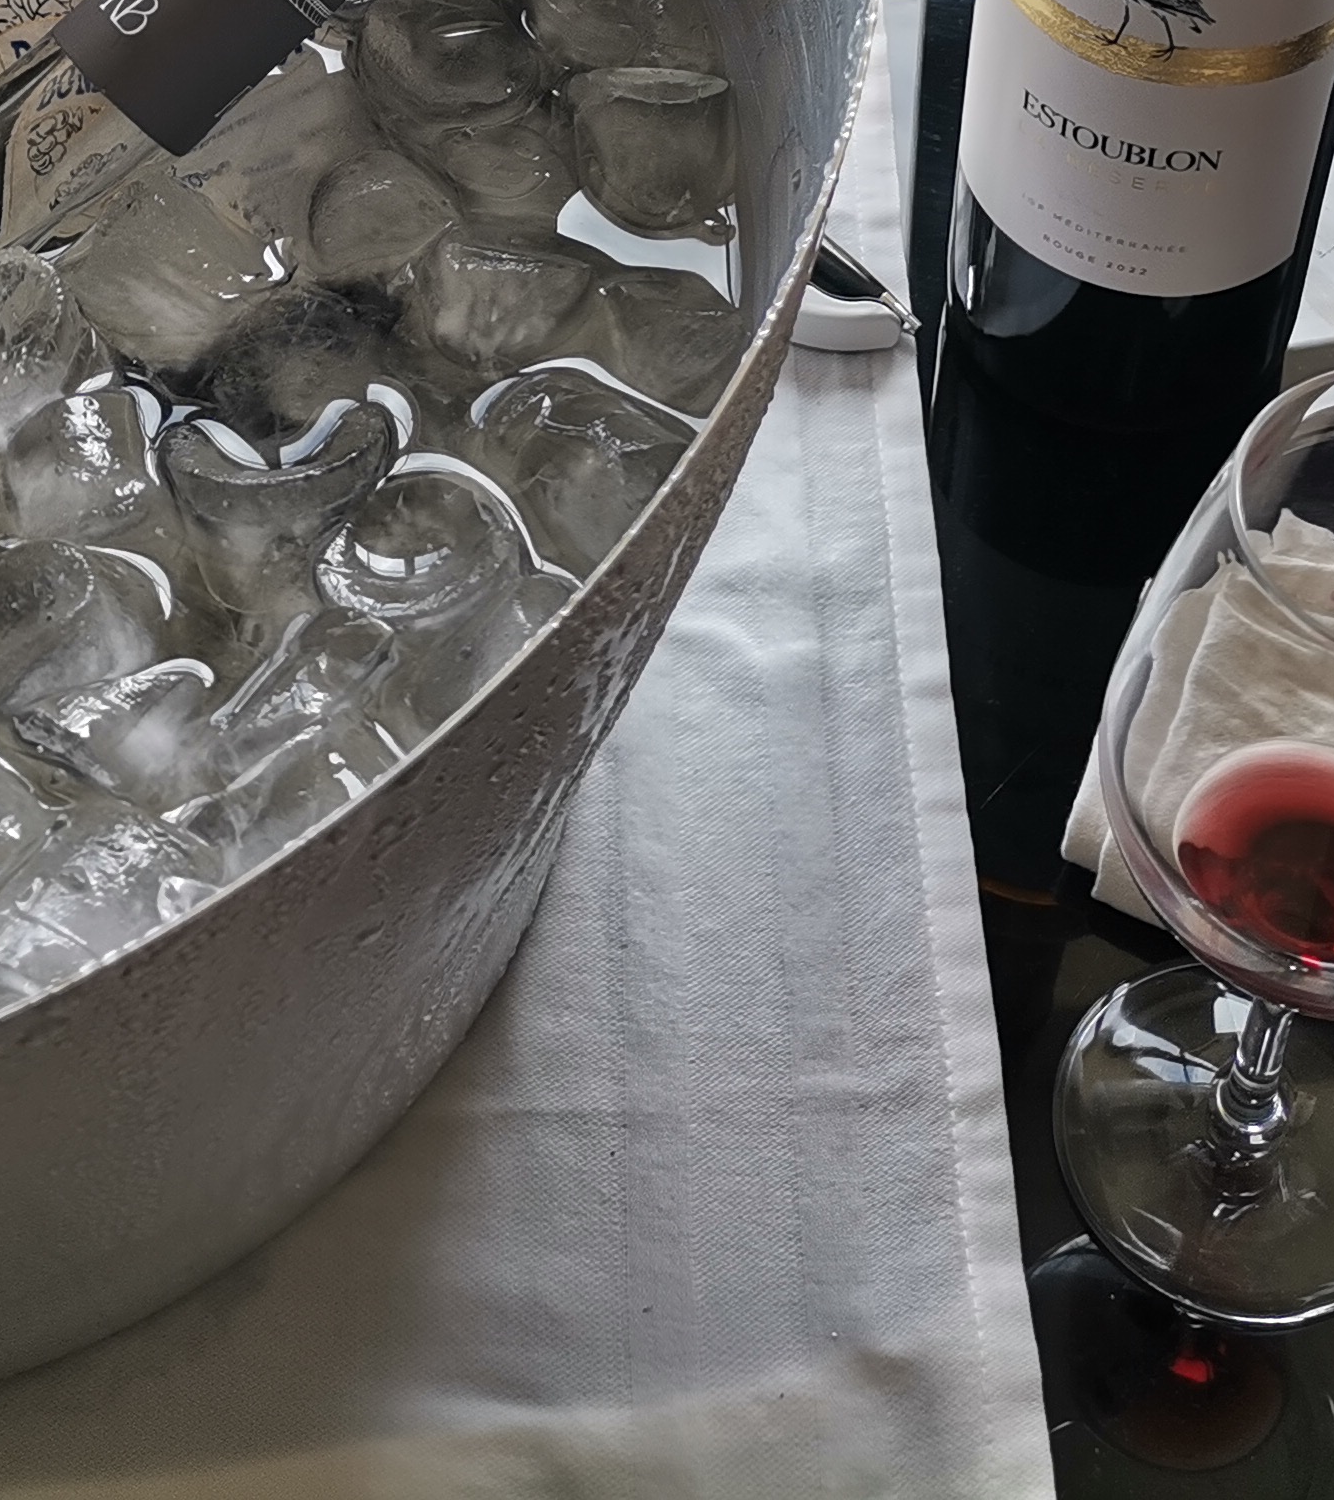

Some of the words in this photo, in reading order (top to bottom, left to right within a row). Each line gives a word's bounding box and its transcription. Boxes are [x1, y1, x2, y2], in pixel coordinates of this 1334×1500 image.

[1022, 87, 1224, 173] ESTOUBLON
[1042, 233, 1096, 264] ROUGE
[1105, 260, 1148, 276] 2022
